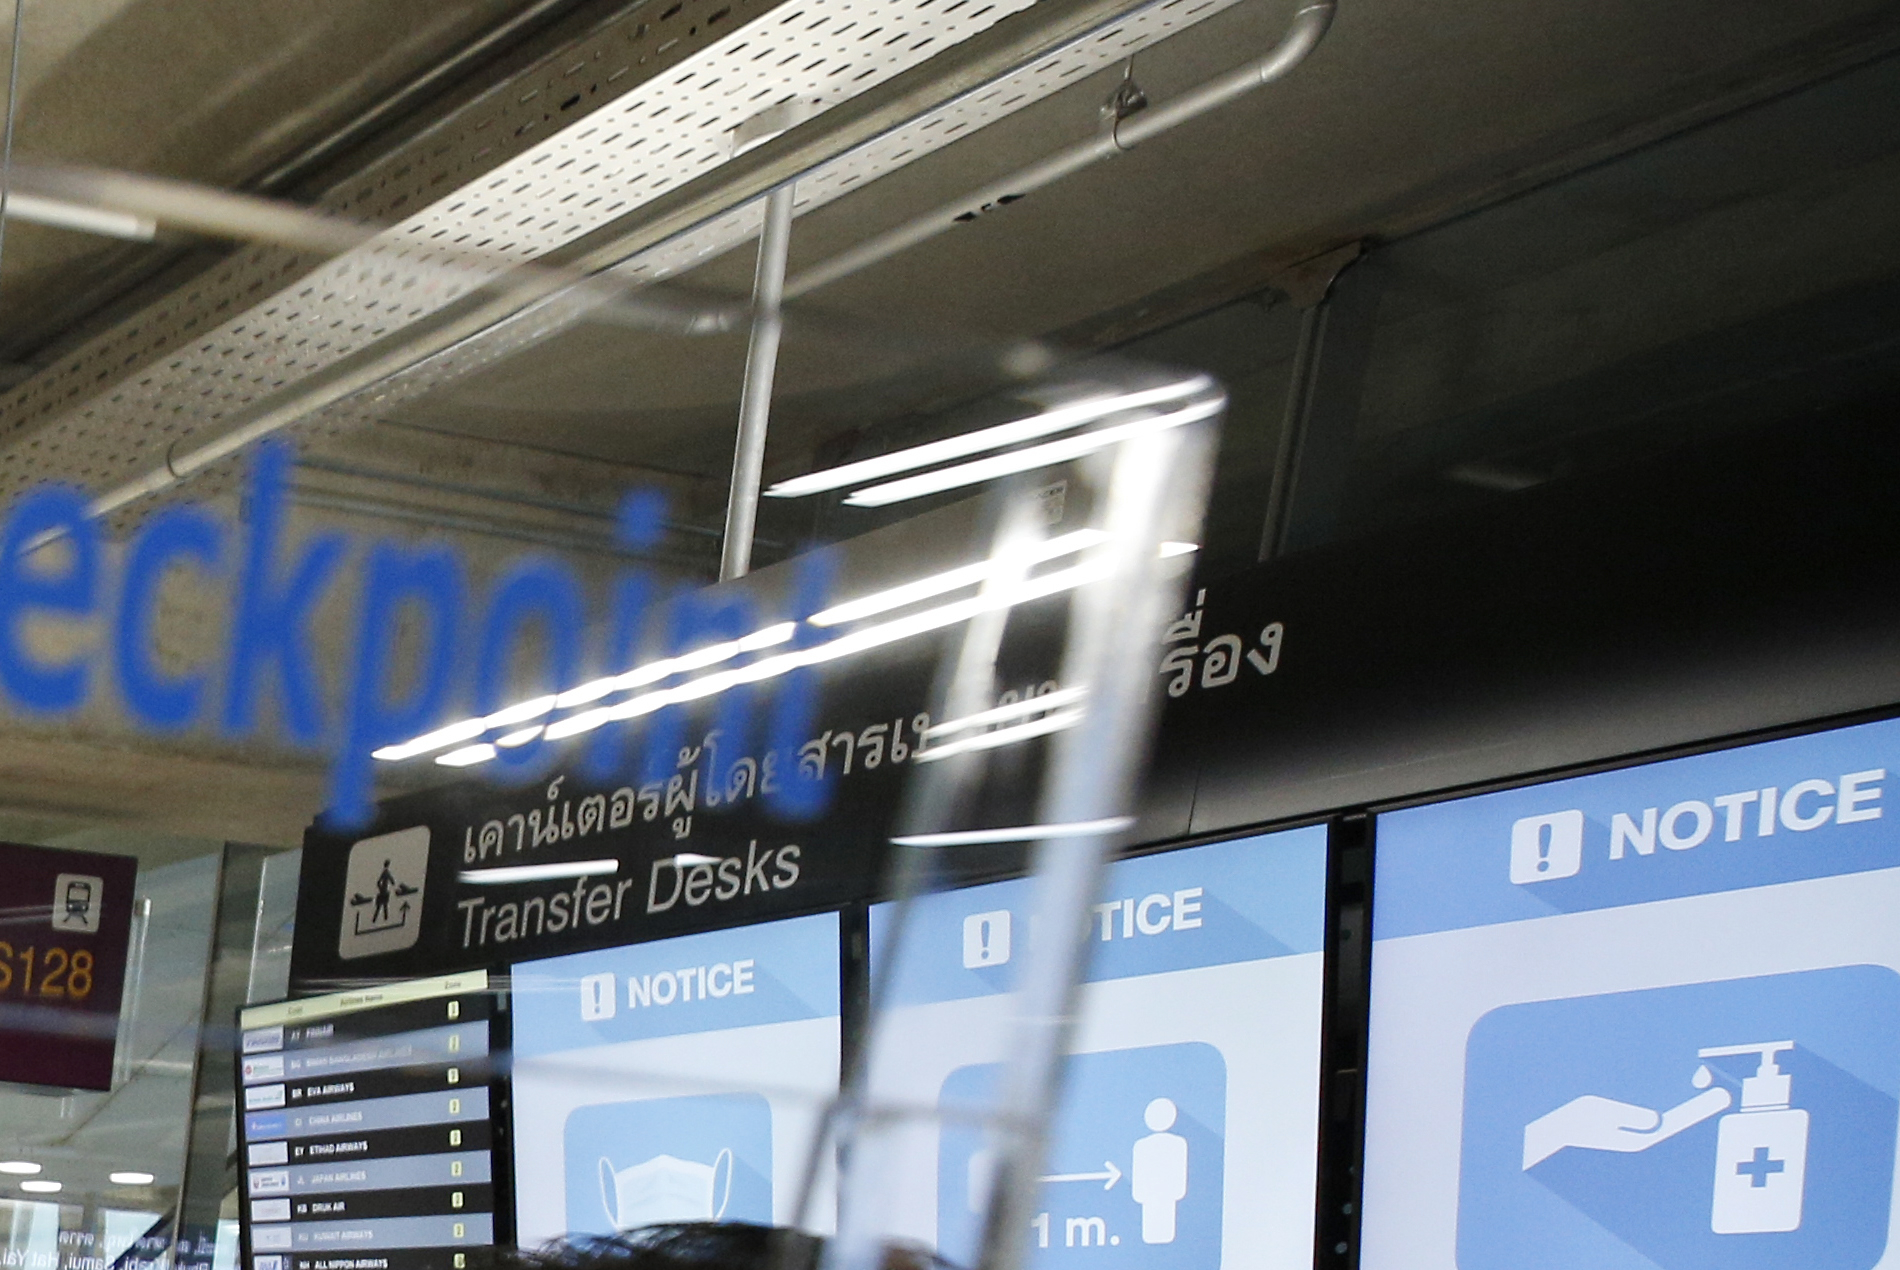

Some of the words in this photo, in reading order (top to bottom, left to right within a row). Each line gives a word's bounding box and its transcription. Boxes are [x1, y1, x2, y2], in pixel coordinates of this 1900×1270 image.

[1609, 767, 1886, 863] NOTICE
[456, 874, 633, 949] Transfer
[645, 838, 801, 913] Desks
[627, 958, 756, 1010] NOTICE
[335, 1140, 368, 1153] AIRWAYS
[314, 1260, 327, 1270] ALL
[328, 1259, 354, 1270] NIPPON
[355, 1258, 388, 1269] AIRWAYS
